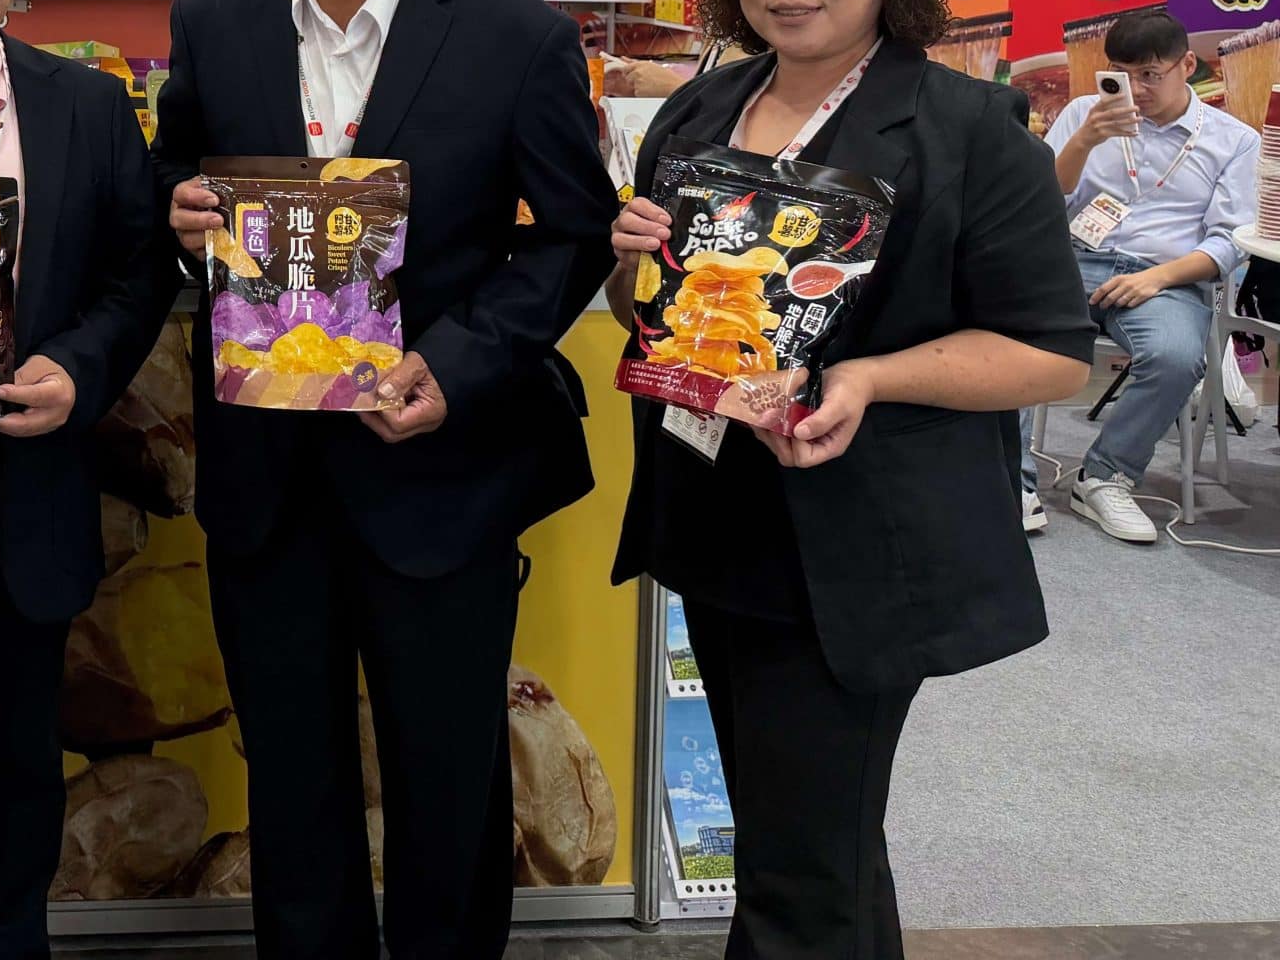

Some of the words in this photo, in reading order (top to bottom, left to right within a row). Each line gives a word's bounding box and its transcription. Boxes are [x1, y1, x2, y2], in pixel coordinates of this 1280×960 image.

[247, 216, 265, 252] 雙色
[286, 206, 316, 321] 地瓜脆片
